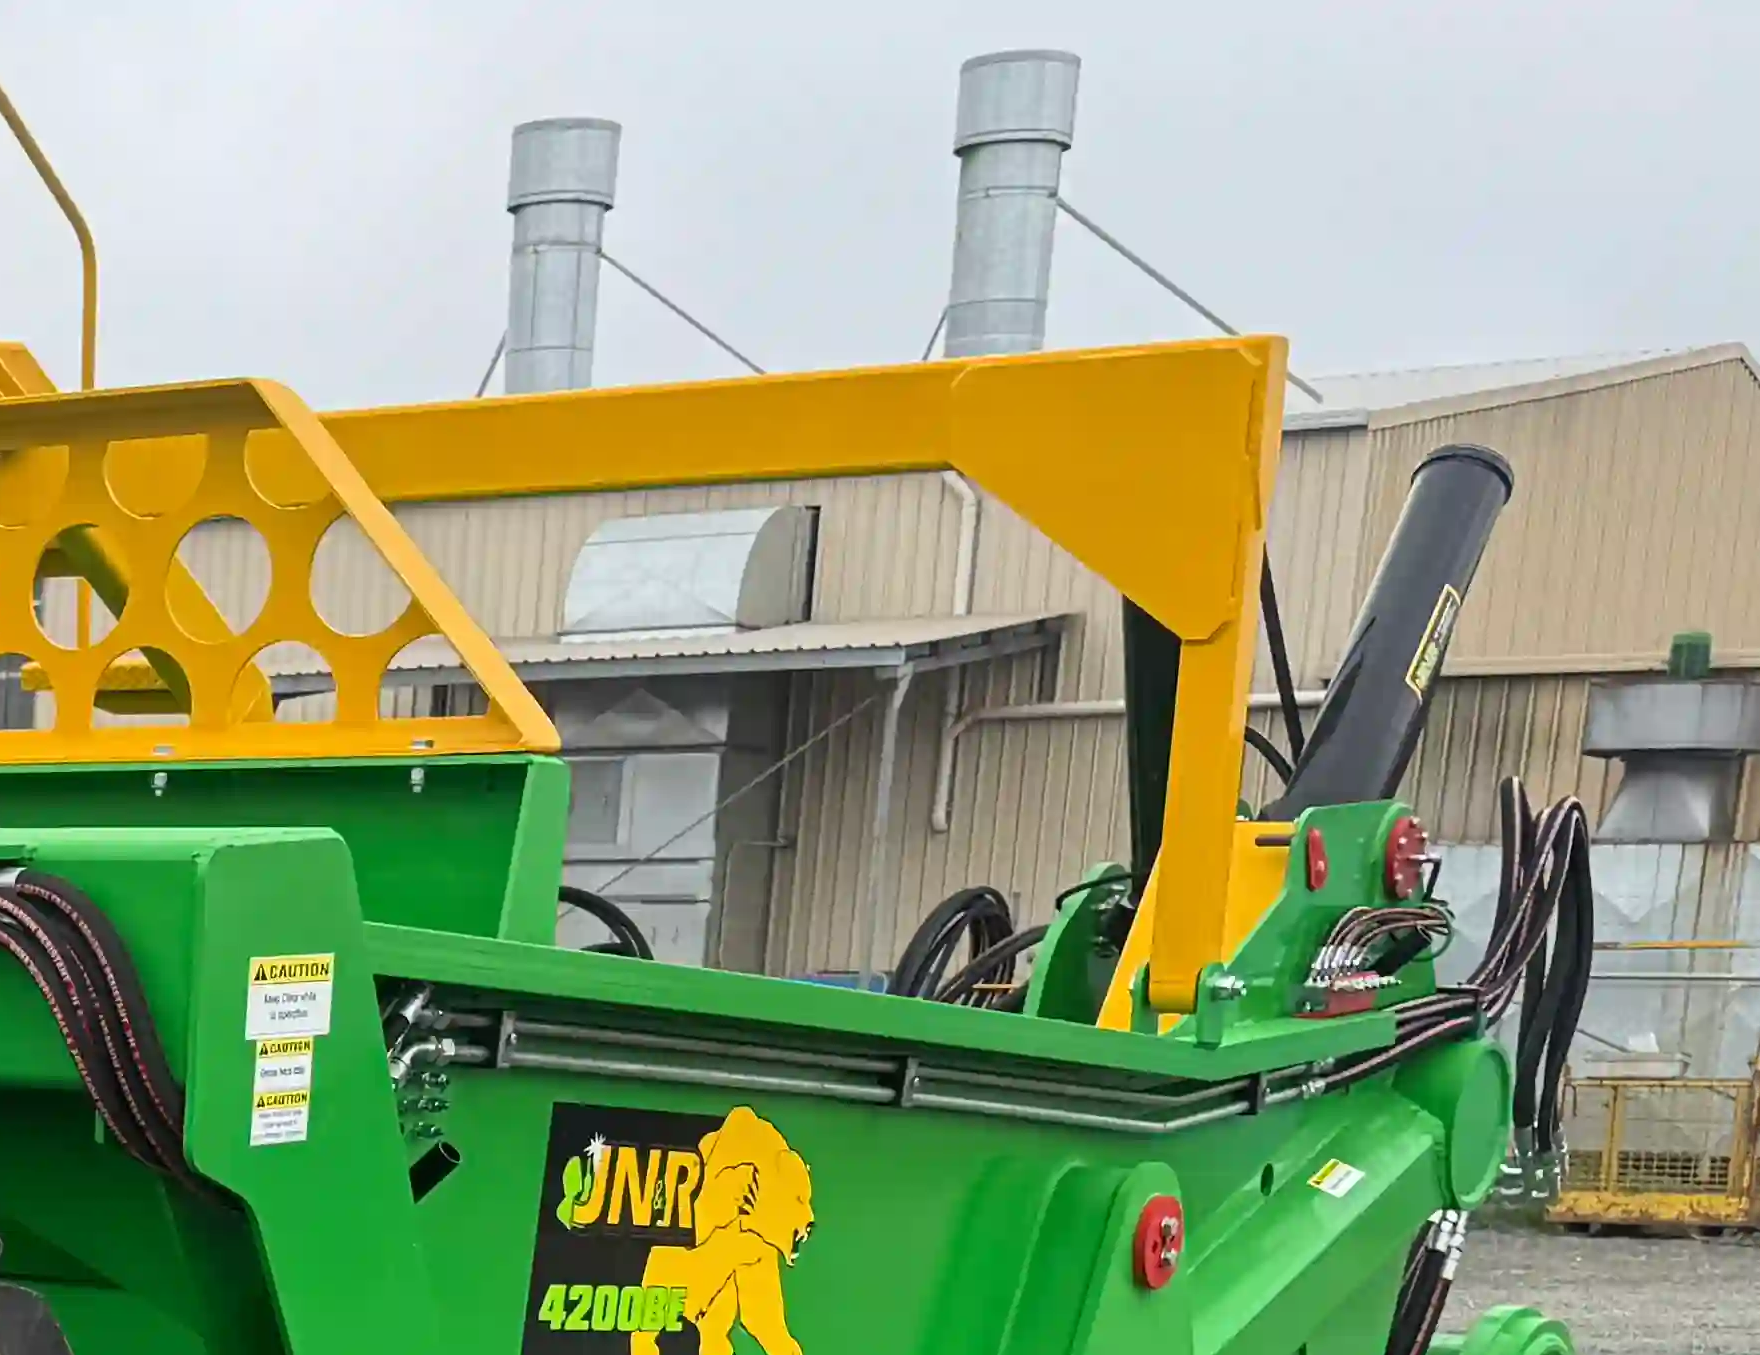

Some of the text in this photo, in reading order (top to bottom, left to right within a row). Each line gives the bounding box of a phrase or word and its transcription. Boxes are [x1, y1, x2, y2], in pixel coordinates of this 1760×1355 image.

[270, 962, 330, 979] CAUTION
[270, 1040, 311, 1054] CAUTION
[266, 1091, 308, 1106] CAUTION
